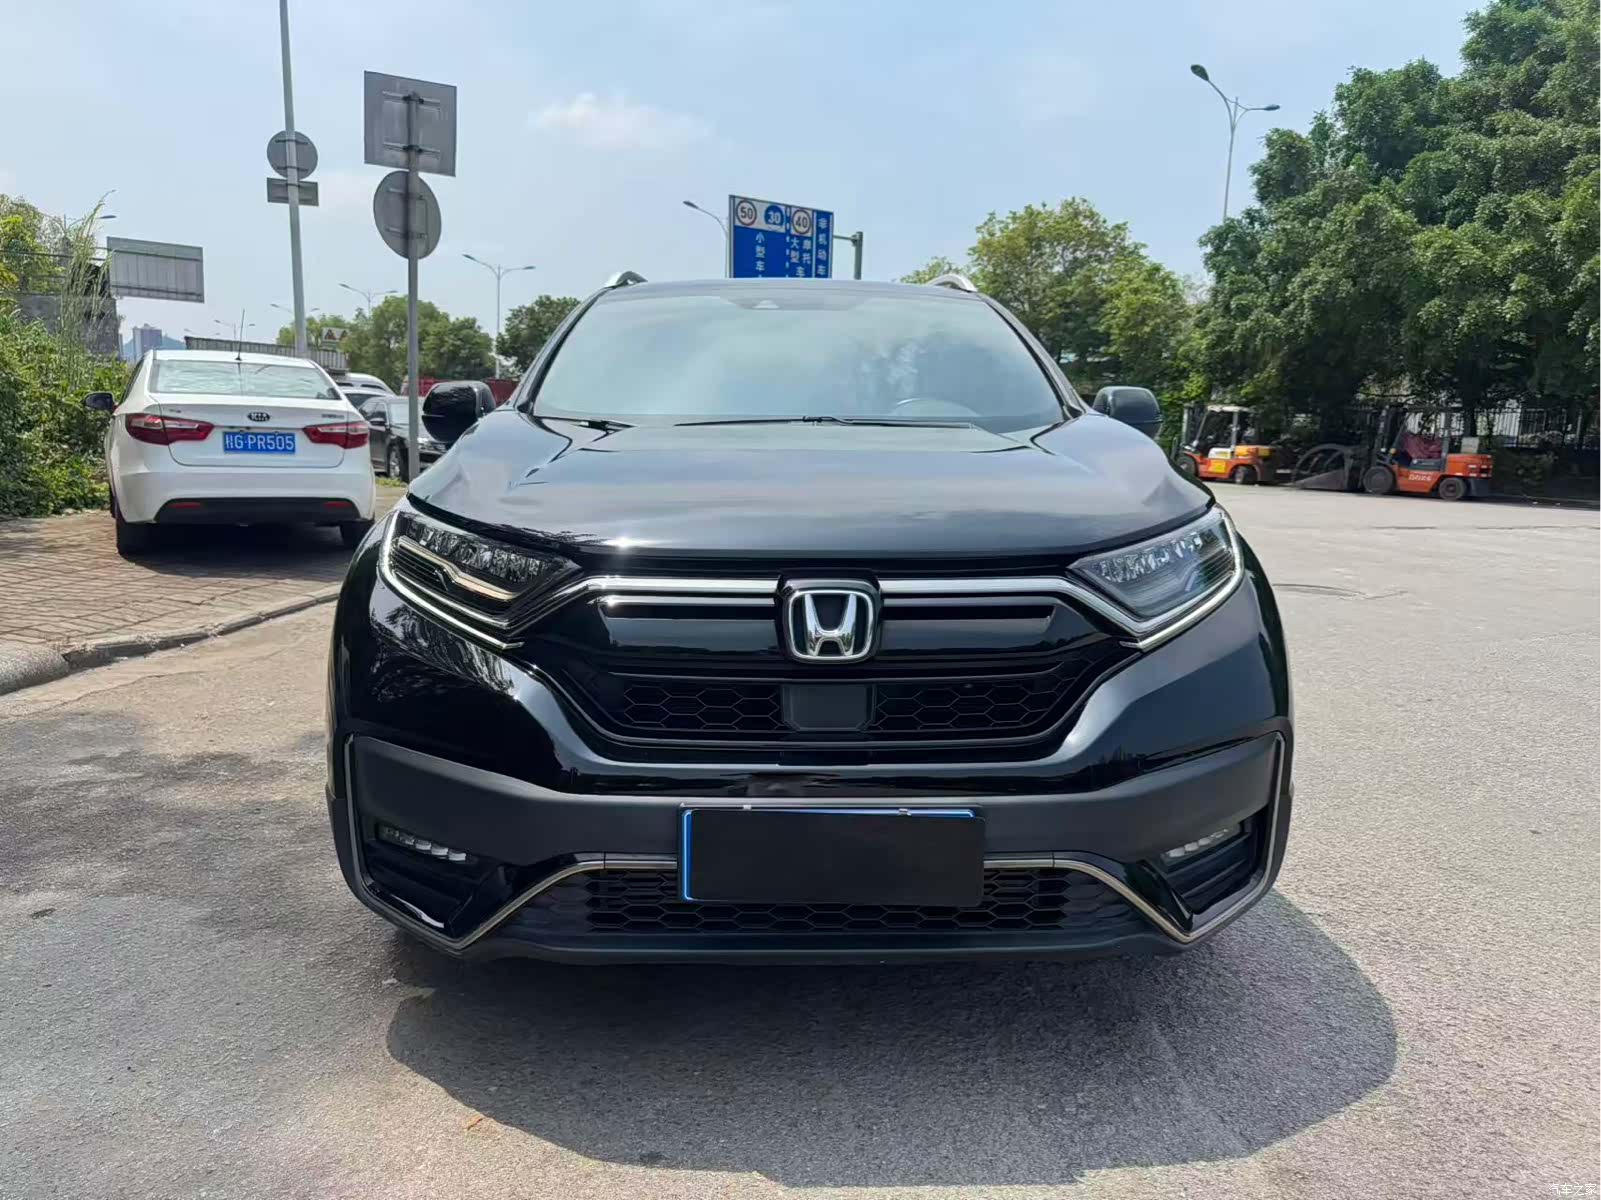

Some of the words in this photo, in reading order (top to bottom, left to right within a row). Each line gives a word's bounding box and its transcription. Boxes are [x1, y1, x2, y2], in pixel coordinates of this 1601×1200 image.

[740, 206, 753, 220] 50
[768, 211, 781, 224] 30
[795, 216, 808, 229] 40
[755, 231, 766, 272] 小型车
[250, 412, 268, 421] KIA
